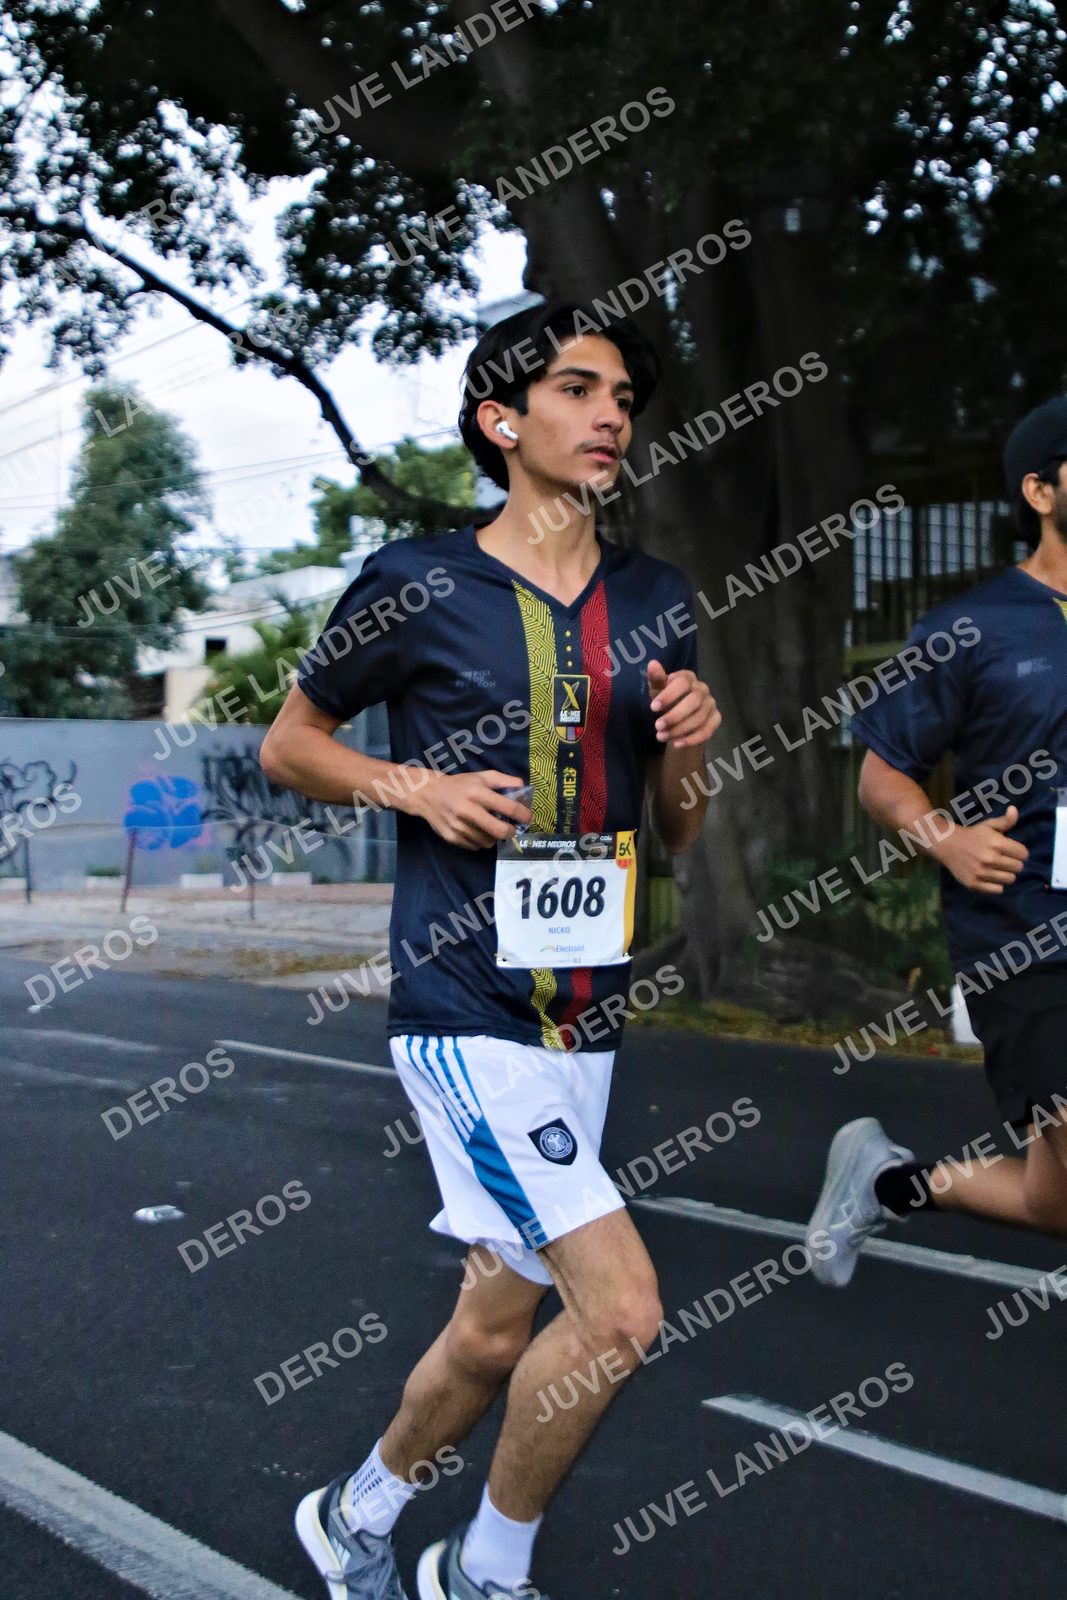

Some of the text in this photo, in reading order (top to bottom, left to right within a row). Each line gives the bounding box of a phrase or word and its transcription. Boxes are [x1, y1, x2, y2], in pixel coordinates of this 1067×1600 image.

[547, 840, 577, 848] NEGROS
[516, 876, 606, 919] 1608
[548, 926, 571, 934] NICKO
